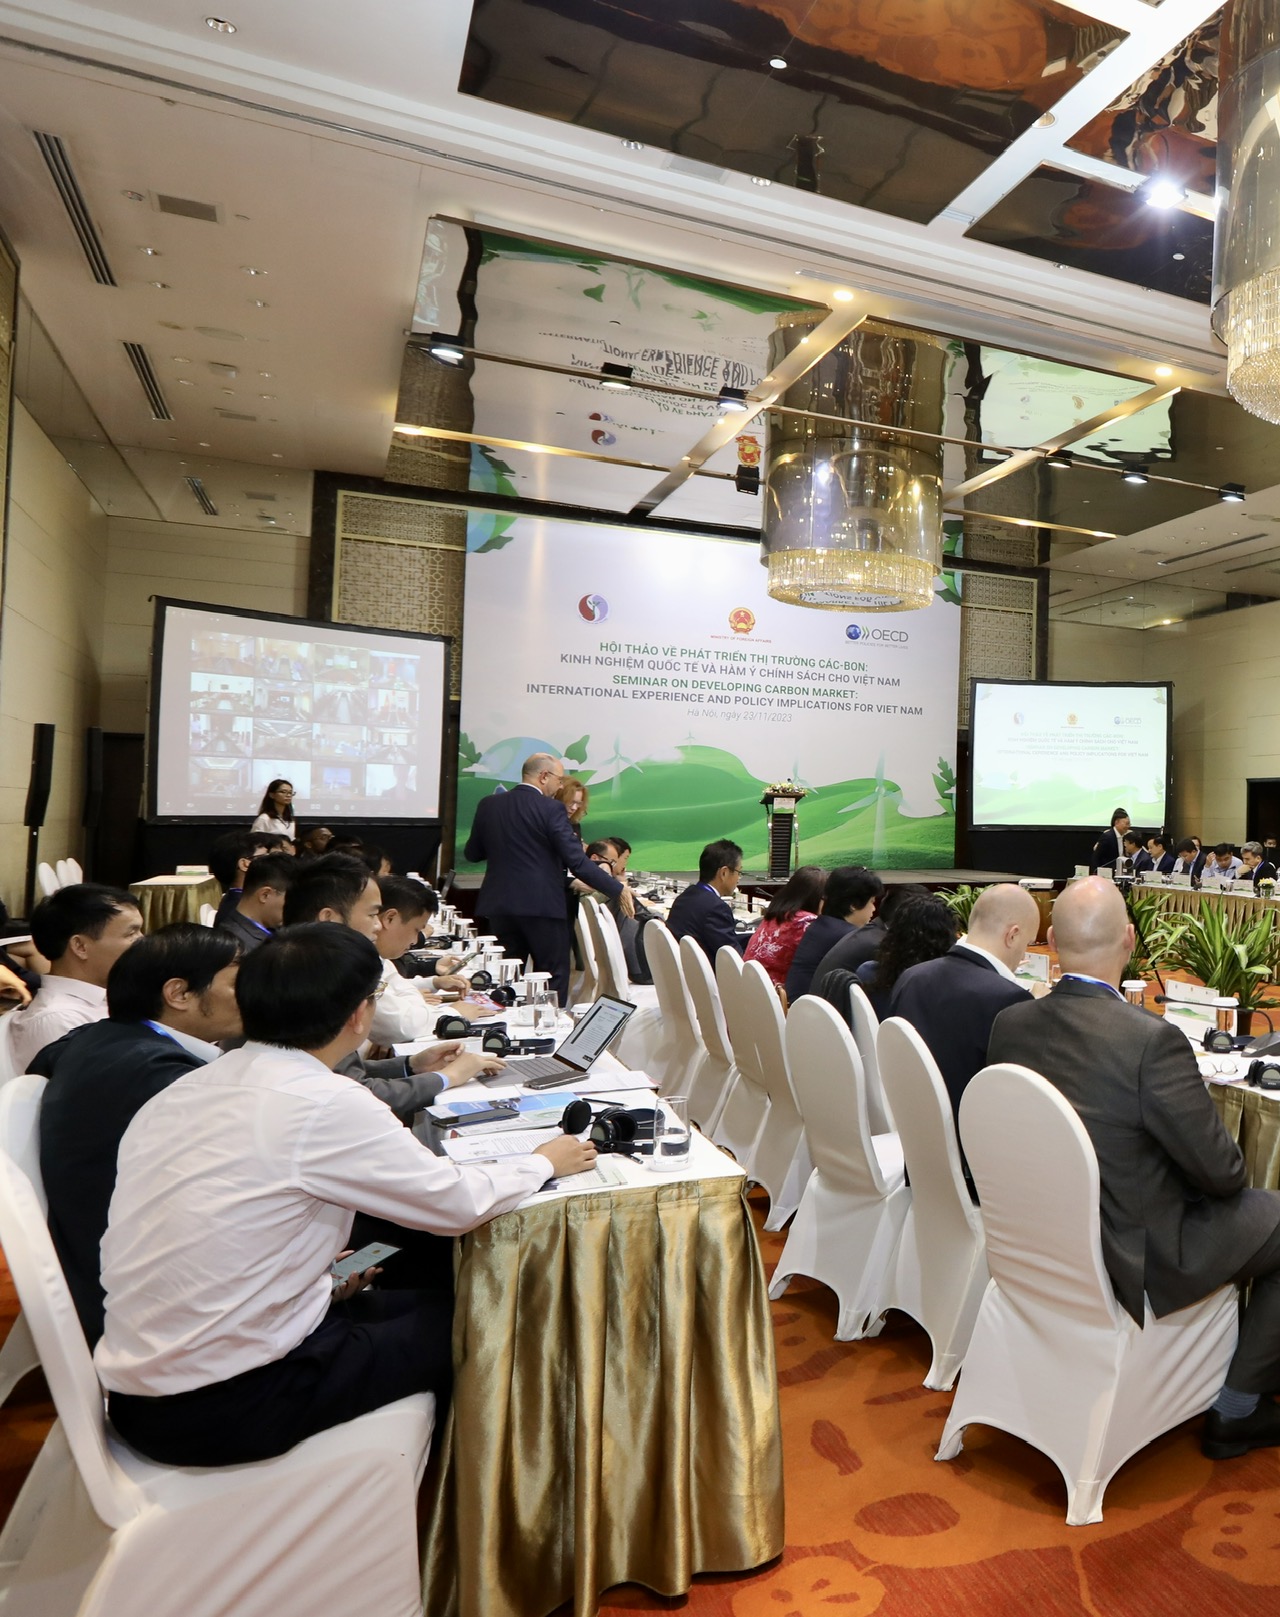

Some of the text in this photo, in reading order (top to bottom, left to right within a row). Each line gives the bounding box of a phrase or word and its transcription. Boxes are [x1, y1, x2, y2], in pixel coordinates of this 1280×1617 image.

[871, 628, 909, 643] OECD
[560, 653, 900, 687] KINH NGHIỆM QUỐC TẾ VÀ HÀM Ý CHÍNH SÁCH CHO VIỆT NAM
[600, 641, 868, 672] HỘI THẢO VỀ PHÁT TRIỂN THỊ TRƯỜNG CÁC-BON:
[526, 683, 923, 716] INTERNATIONAL EXPERIENCE AND POLICY IMPLICATIONS FOR VIET NAM
[612, 674, 858, 700] SEMINAR ON DEVELOPING CARBON MARKET:
[720, 711, 742, 721] ngày
[743, 711, 793, 723] 23/11/2023
